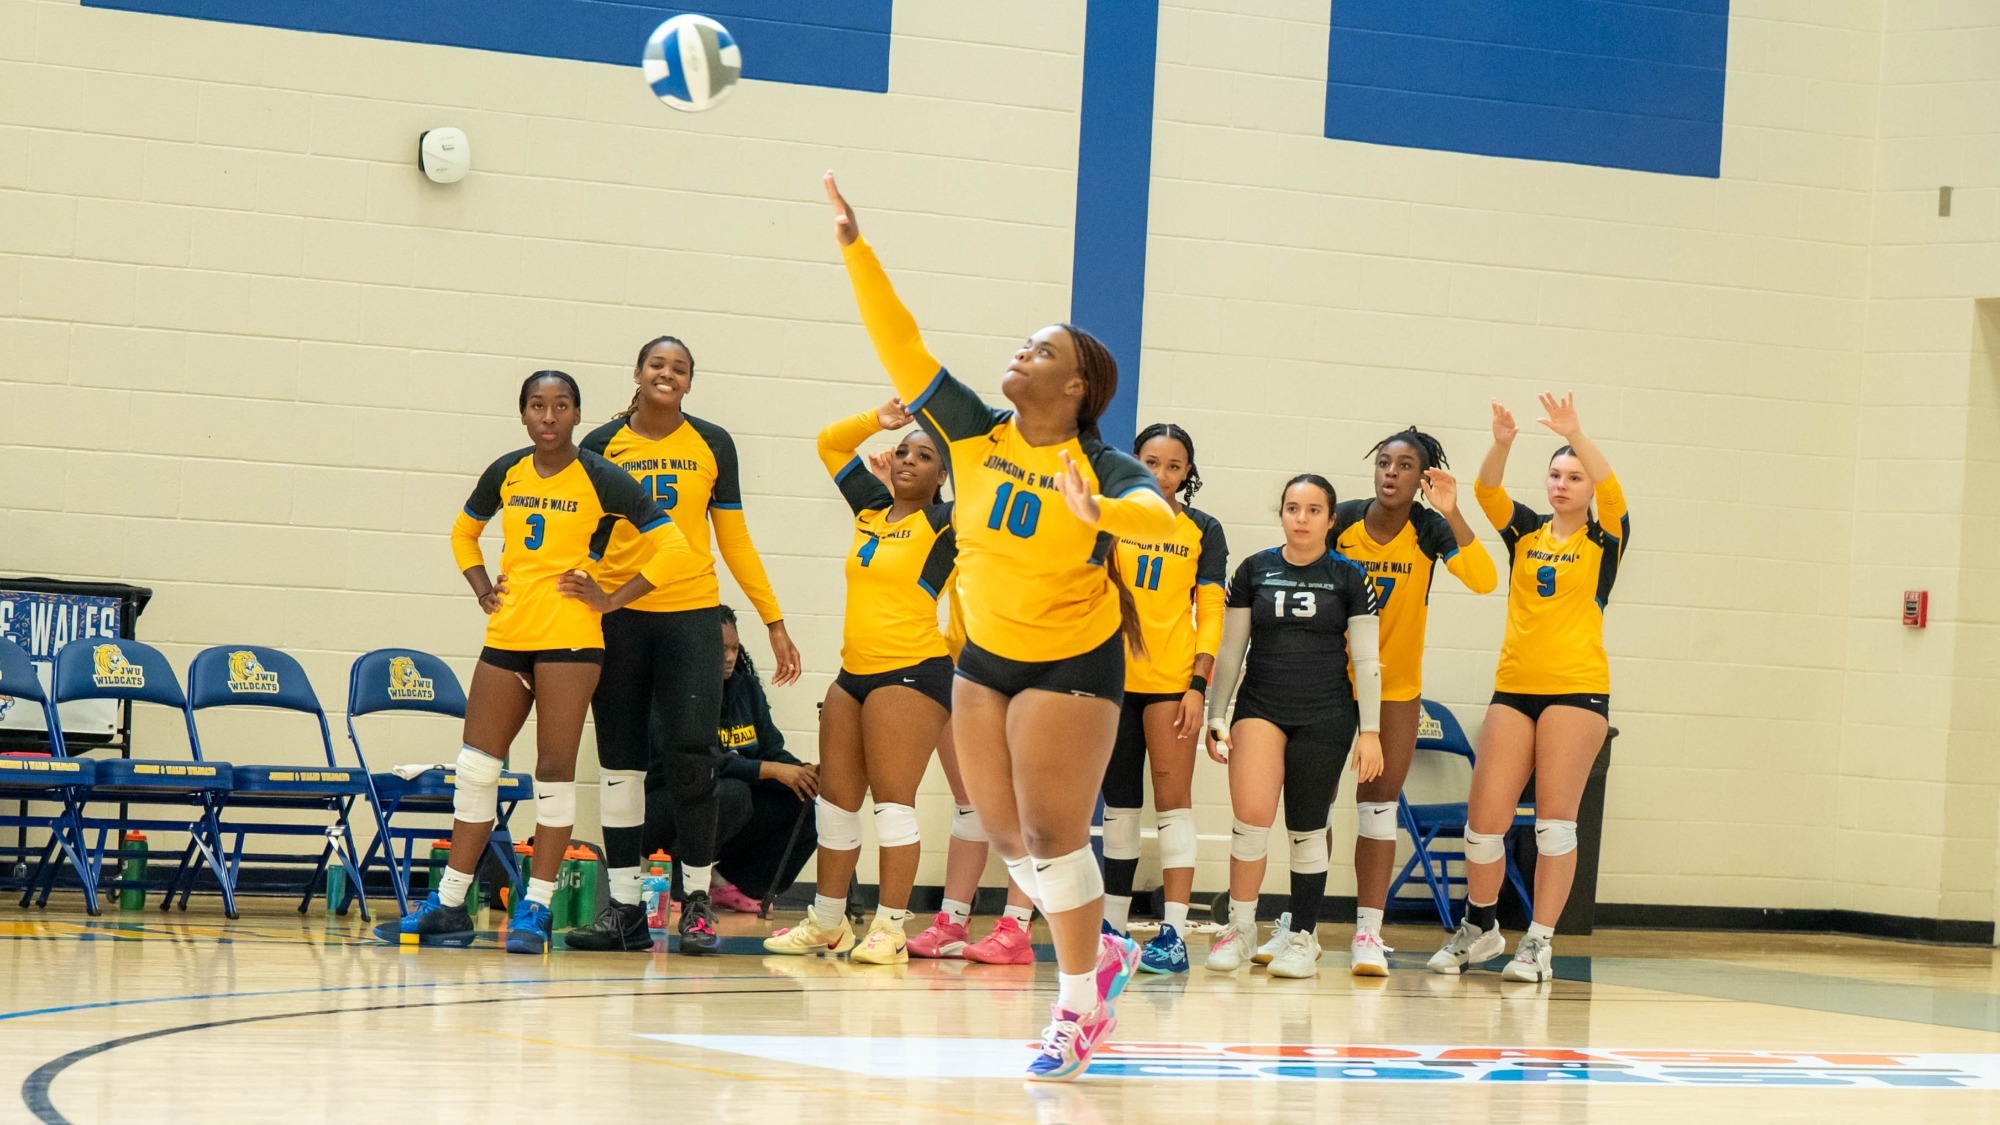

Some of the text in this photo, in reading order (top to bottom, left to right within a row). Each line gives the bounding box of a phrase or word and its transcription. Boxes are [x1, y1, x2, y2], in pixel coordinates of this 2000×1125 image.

[670, 459, 697, 471] WALES
[983, 455, 1025, 482] JOHNSON
[1027, 472, 1035, 486] &
[508, 495, 578, 513] JOHNSON & WALES
[641, 474, 677, 511] 15
[987, 481, 1042, 539] 10
[524, 513, 546, 551] 3
[856, 536, 880, 567] 4
[1163, 542, 1189, 558] WALES
[1134, 554, 1164, 592] 11
[1536, 565, 1556, 598] 9
[1274, 590, 1317, 618] 13
[95, 675, 143, 686] WILDCATS
[120, 666, 141, 676] JWU
[255, 673, 276, 682] JWU
[230, 682, 278, 692] WILDCATS
[390, 689, 433, 698] WILDCATS
[412, 679, 431, 689] JWU
[1026, 1042, 1920, 1066] COAST
[1086, 1063, 1981, 1087] COAST
